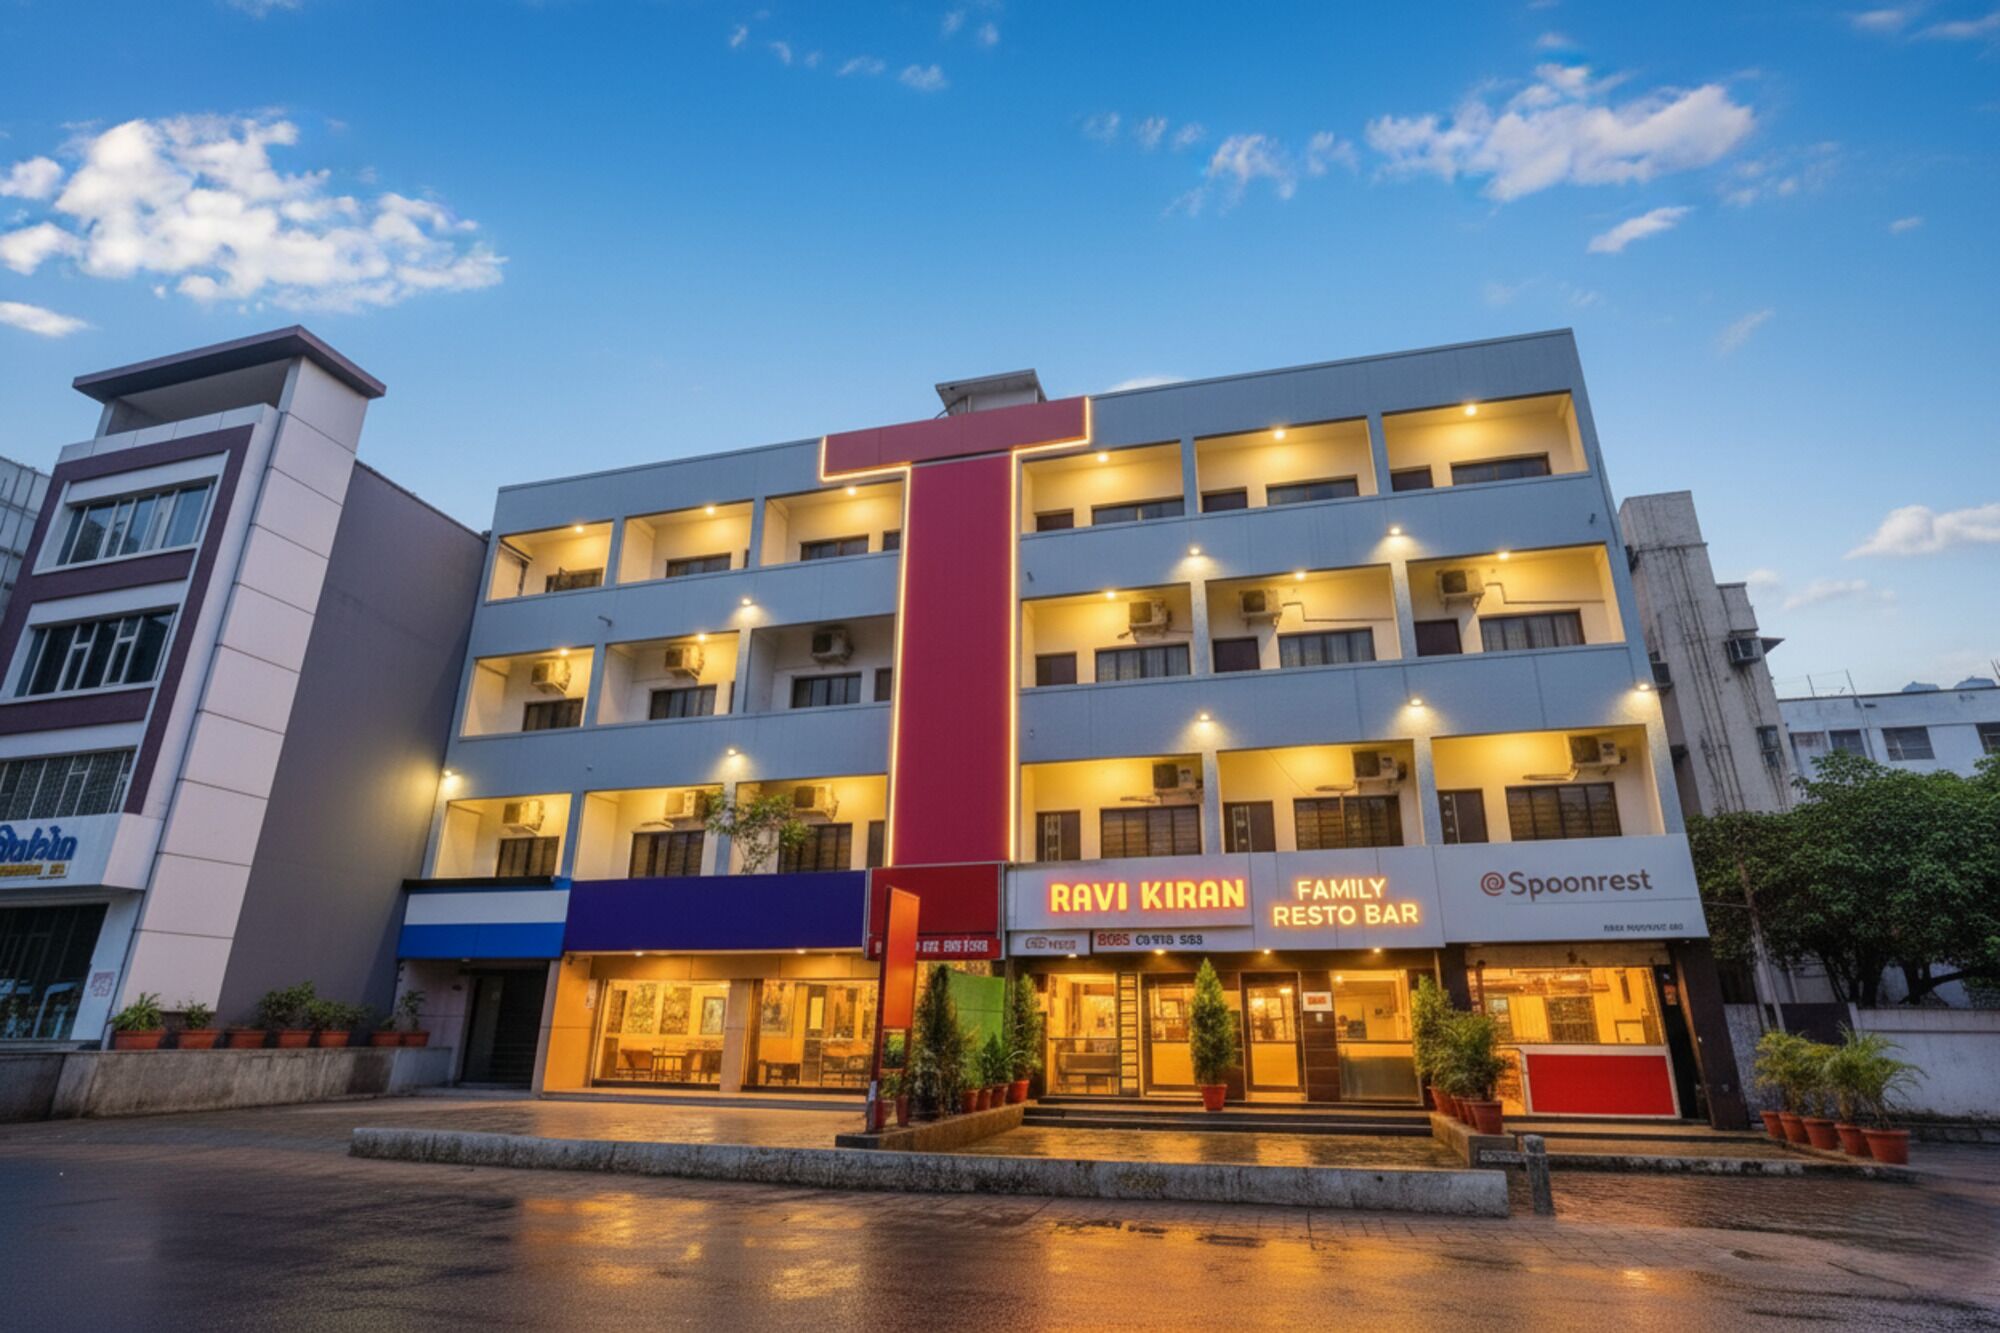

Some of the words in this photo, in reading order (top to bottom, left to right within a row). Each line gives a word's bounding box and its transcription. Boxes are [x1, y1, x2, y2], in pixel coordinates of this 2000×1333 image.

[1050, 882, 1127, 912] RAVI
[1141, 879, 1245, 909] KIRAN
[1297, 878, 1387, 900] FAMILY
[1273, 905, 1356, 927] RESTO
[1364, 903, 1419, 925] BAR
